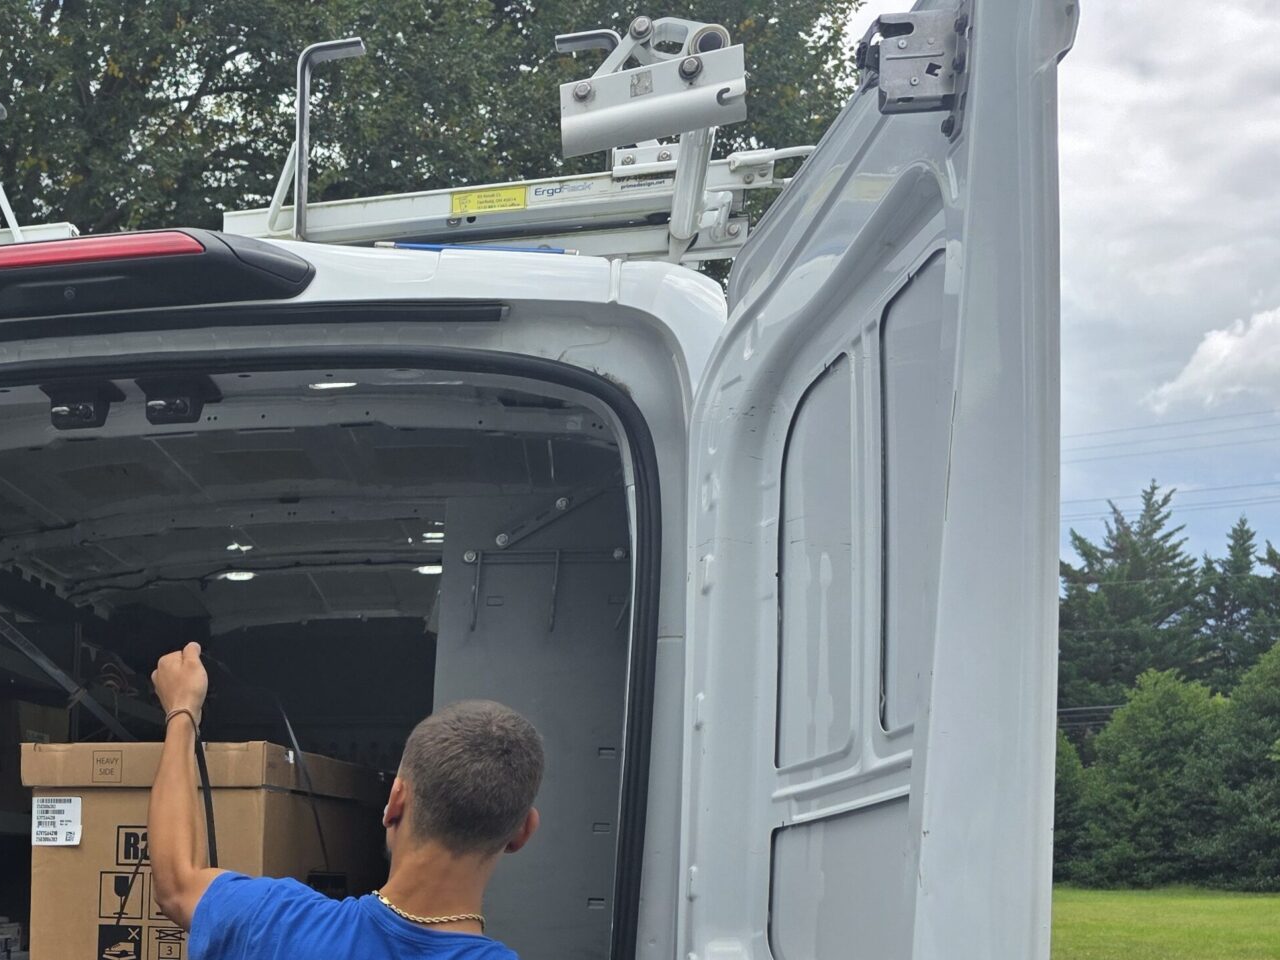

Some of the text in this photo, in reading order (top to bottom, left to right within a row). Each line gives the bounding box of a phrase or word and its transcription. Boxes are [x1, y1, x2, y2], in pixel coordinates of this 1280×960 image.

[96, 757, 119, 765] HEAVY
[99, 767, 115, 776] SIDE
[166, 945, 173, 956] 3
